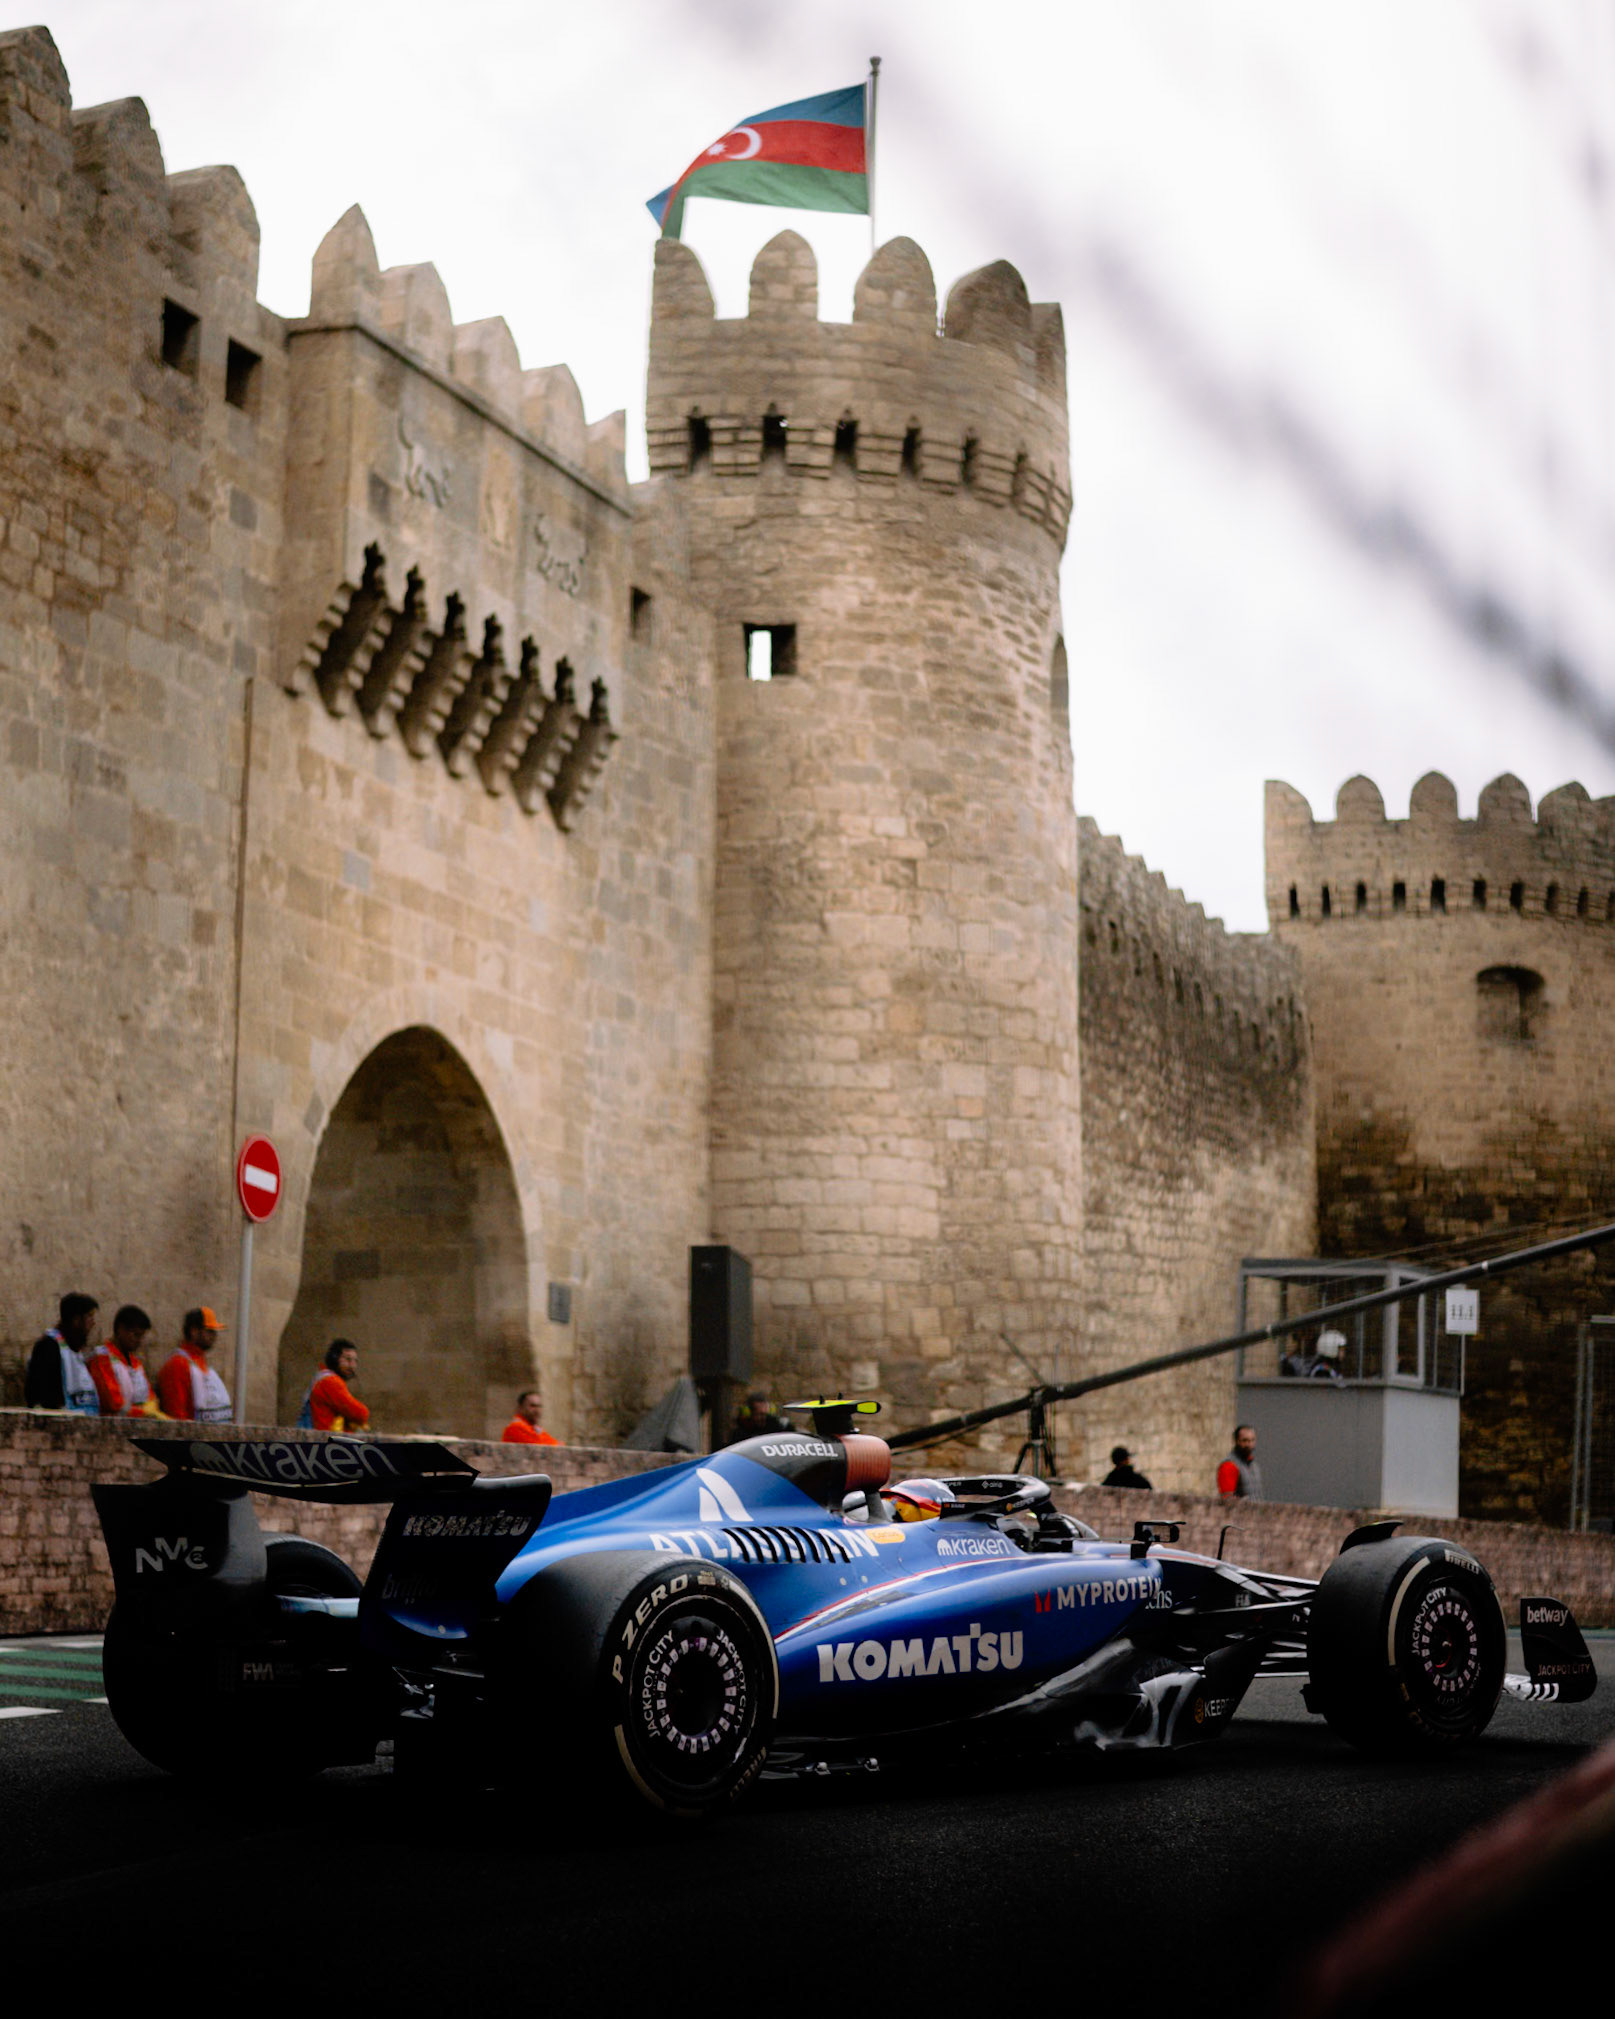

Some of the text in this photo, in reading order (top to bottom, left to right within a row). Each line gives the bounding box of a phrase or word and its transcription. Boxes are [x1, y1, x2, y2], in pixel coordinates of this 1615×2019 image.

[223, 1442, 403, 1481] kraken
[761, 1442, 839, 1457] DURACELL
[402, 1509, 532, 1537] KOMATSU
[950, 1537, 1011, 1555] kraken
[612, 1573, 689, 1684] P ZERO
[1411, 1586, 1448, 1657] JACKPOT CITY
[1527, 1606, 1569, 1627] betway
[716, 1628, 747, 1692] JACKPOT
[816, 1622, 1024, 1683] KOMATSU
[1537, 1663, 1592, 1677] JACKPOT CITY
[642, 1629, 674, 1738] JACKPOT CITY
